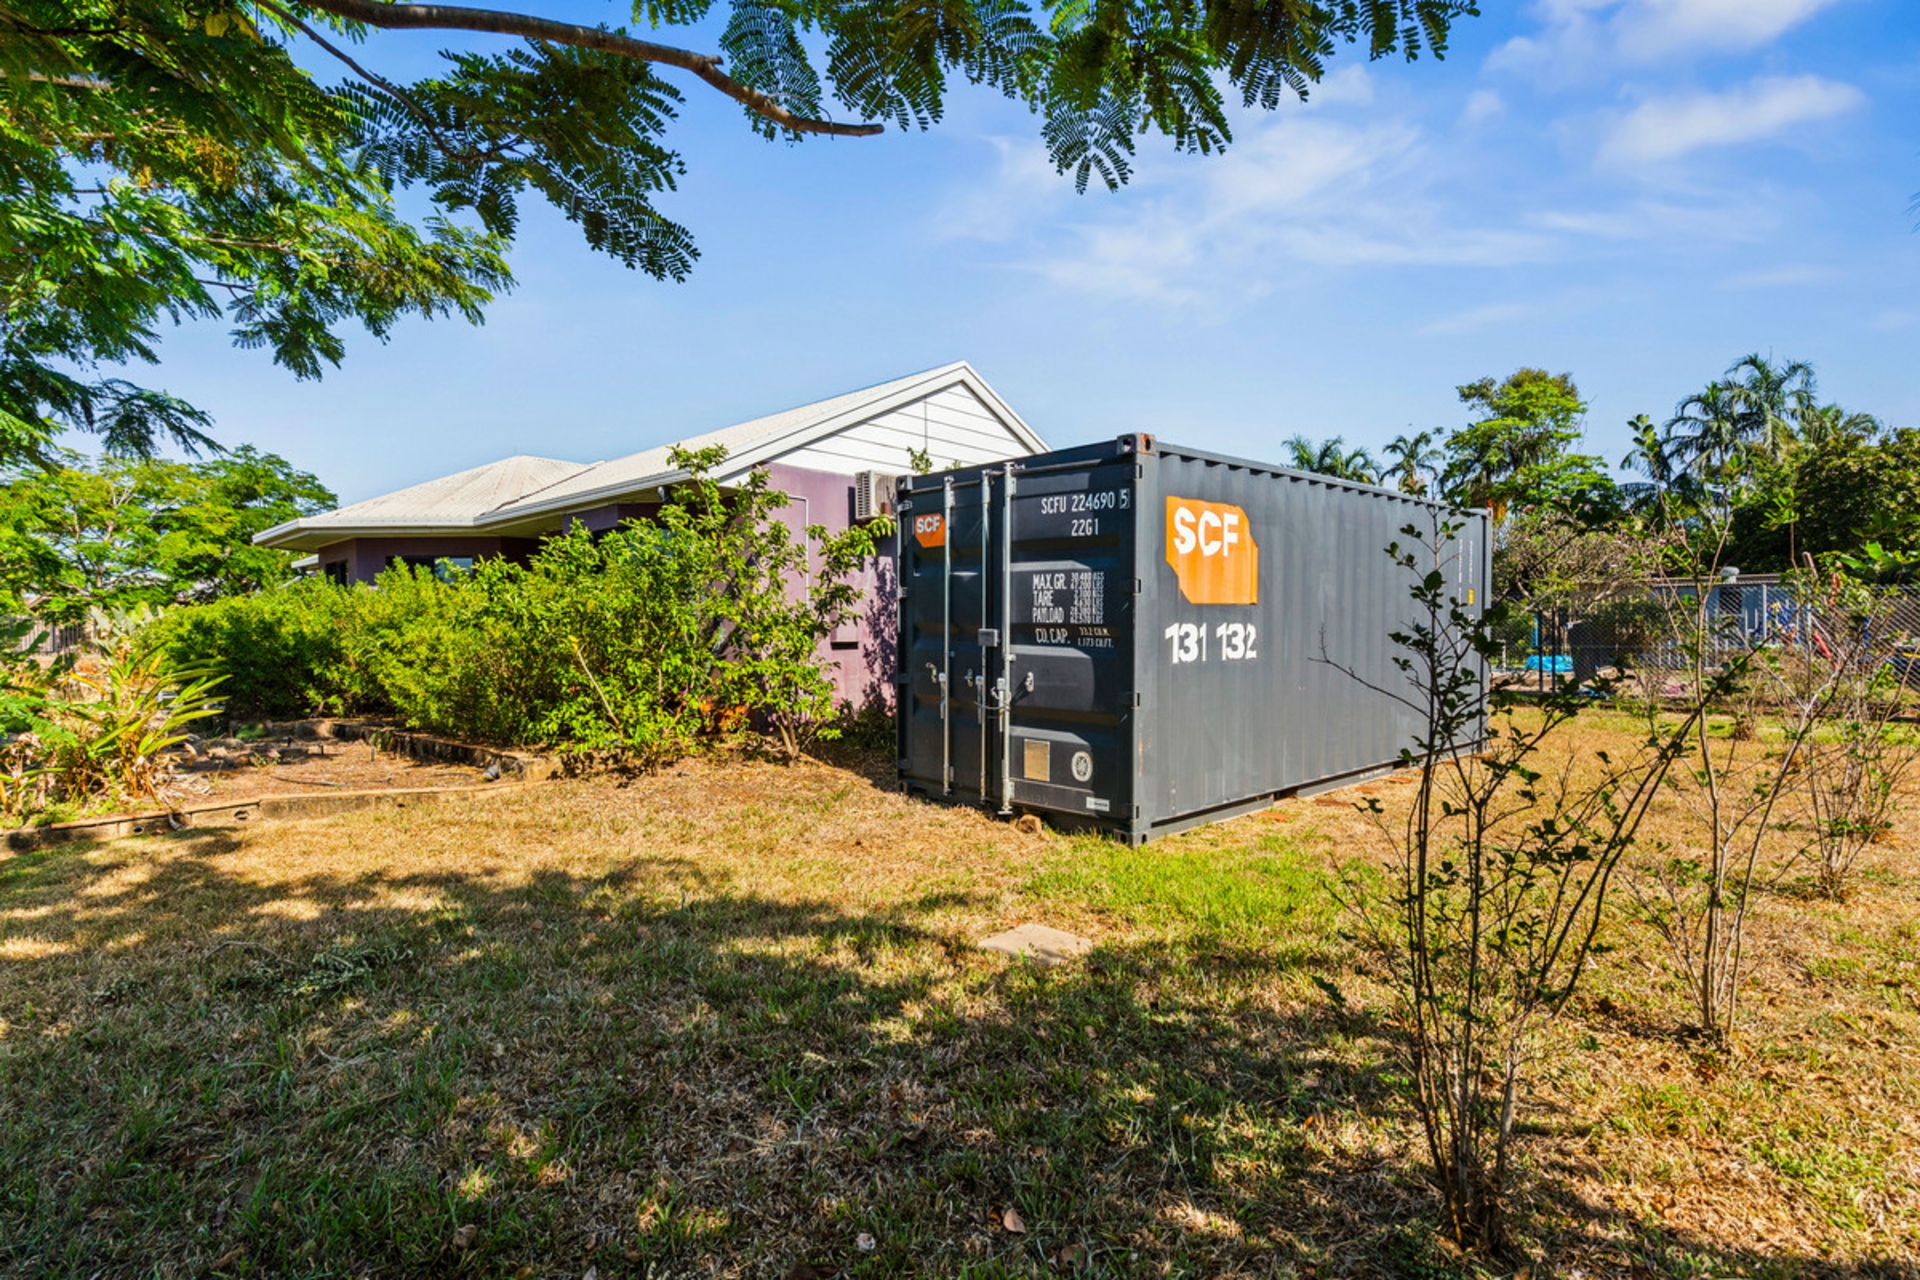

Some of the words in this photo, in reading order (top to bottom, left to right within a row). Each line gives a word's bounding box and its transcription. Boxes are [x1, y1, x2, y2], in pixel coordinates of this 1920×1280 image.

[1041, 495, 1067, 514] SCFU
[1071, 490, 1115, 512] 224690
[1120, 488, 1129, 509] 5
[916, 516, 940, 533] SCF
[1071, 518, 1099, 536] 22G1
[1173, 506, 1239, 557] SCF
[1033, 590, 1054, 607] TARE
[1032, 607, 1065, 623] PAYLOAD
[1165, 622, 1207, 664] 131
[1216, 622, 1257, 661] 132
